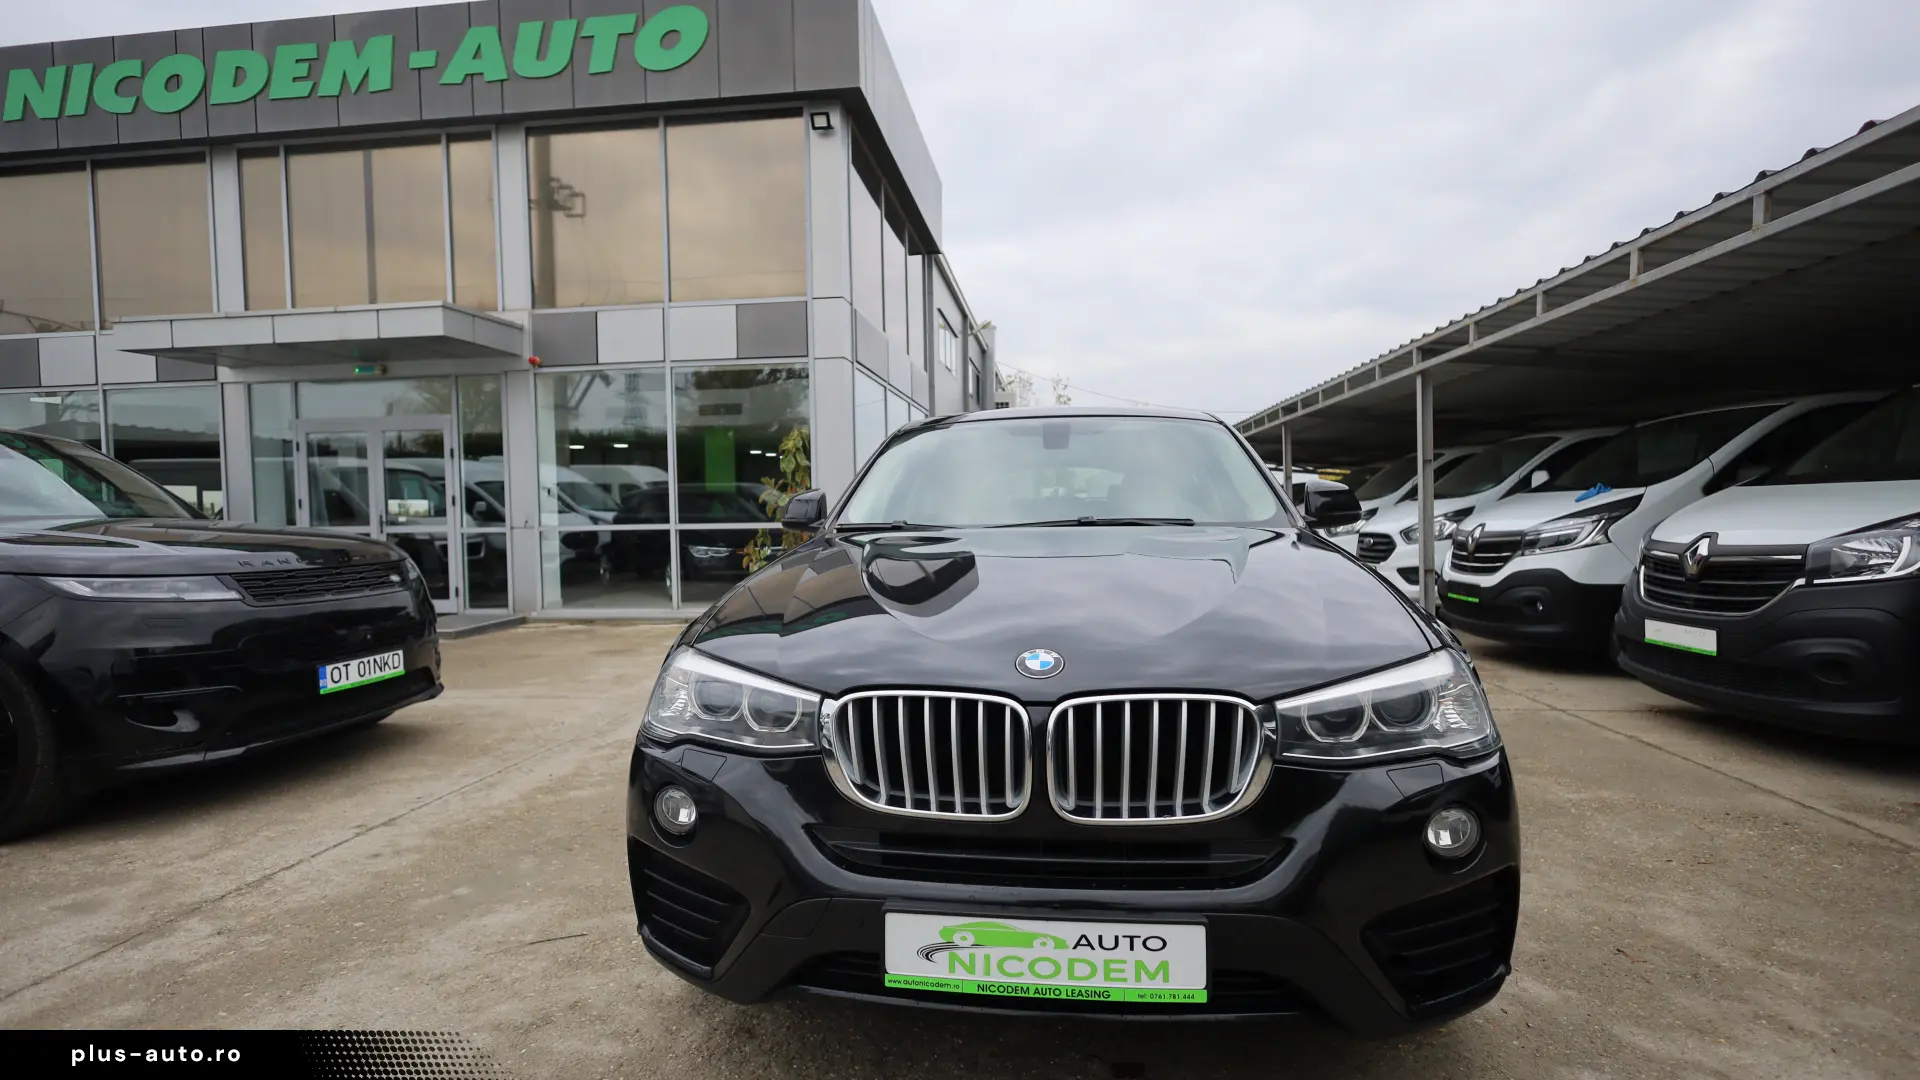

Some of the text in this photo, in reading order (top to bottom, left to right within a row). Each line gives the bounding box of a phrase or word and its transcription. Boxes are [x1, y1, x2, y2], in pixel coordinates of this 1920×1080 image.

[330, 663, 351, 684] OT
[1072, 934, 1167, 952] AUTO
[948, 952, 1170, 983] NICODEM
[887, 978, 960, 989] www.autonicodem.ro
[977, 984, 1111, 999] NICODEM AUTO LEASING
